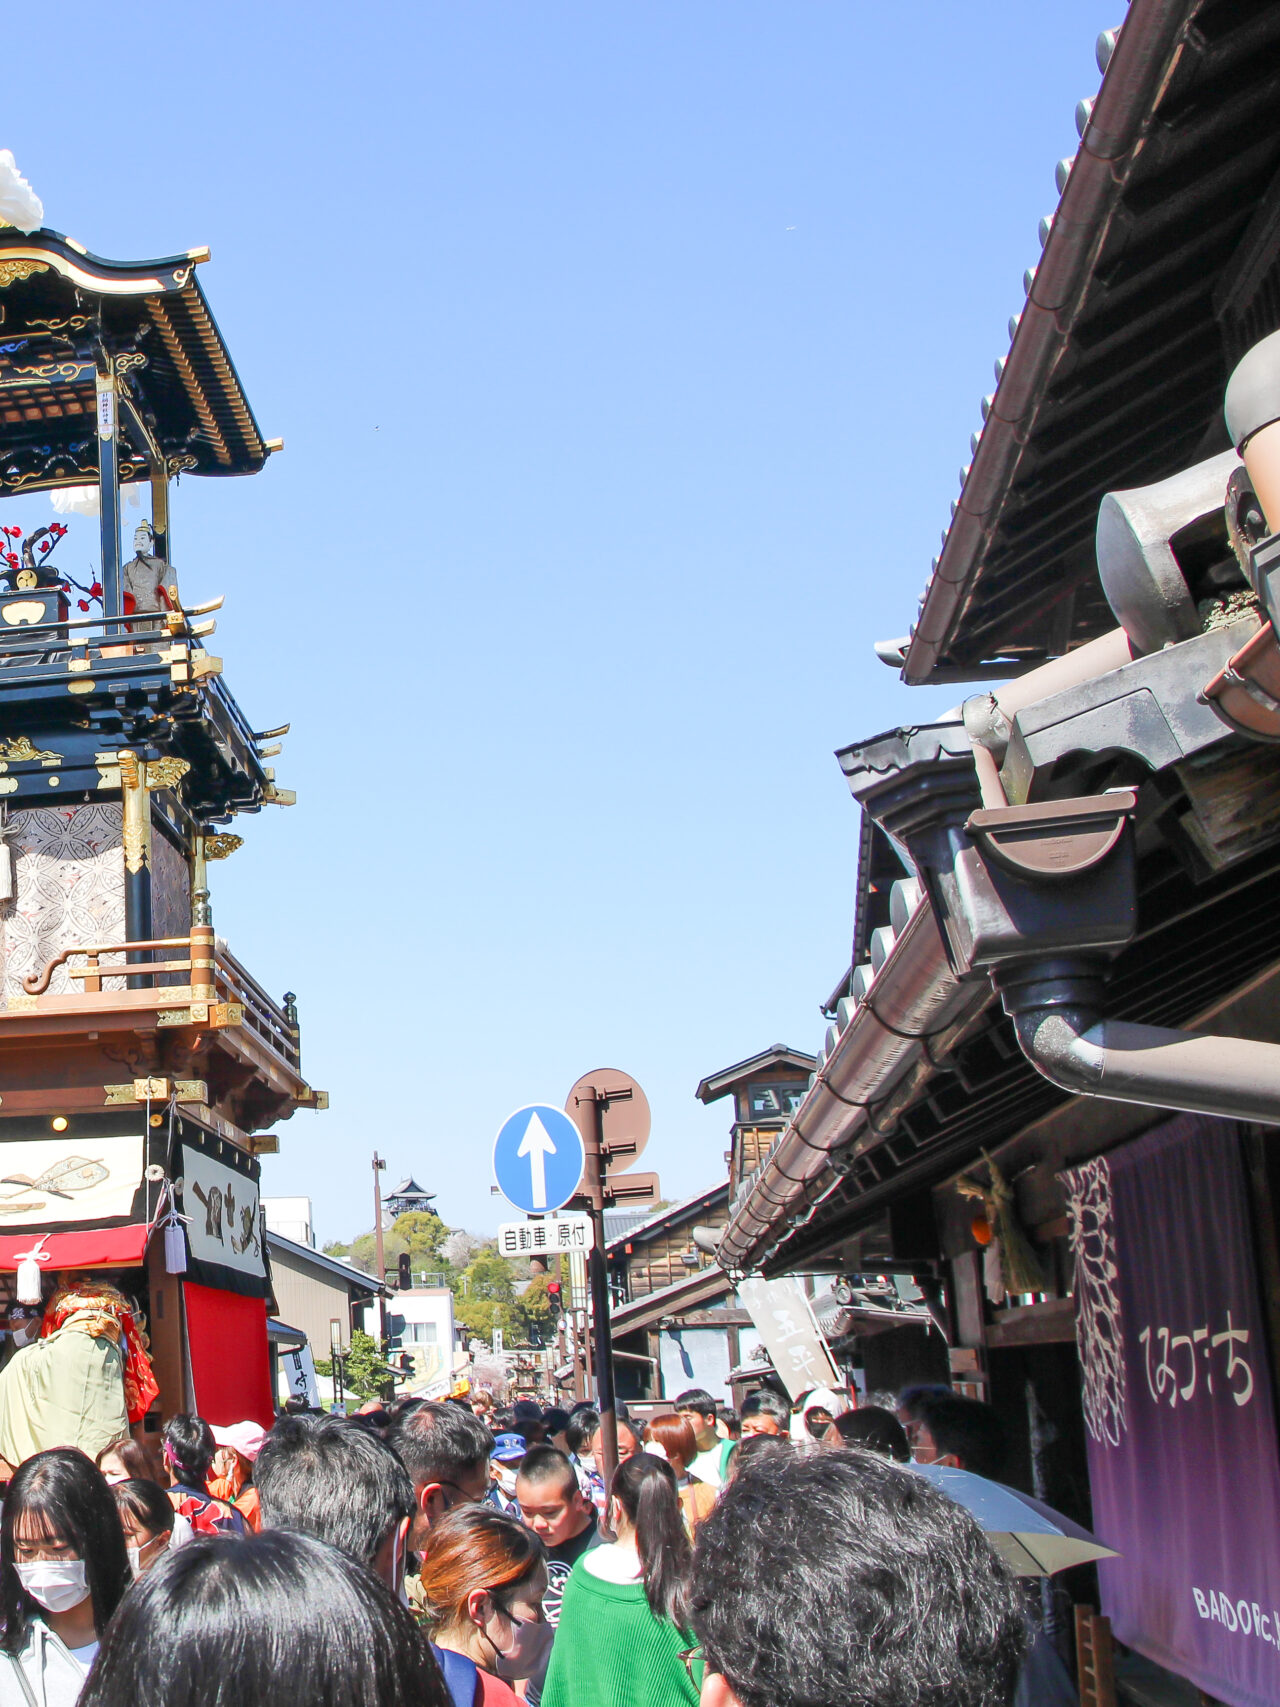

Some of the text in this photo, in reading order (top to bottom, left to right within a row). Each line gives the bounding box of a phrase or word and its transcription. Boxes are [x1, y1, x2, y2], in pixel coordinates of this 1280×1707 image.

[505, 1221, 585, 1251] 自動車・原付
